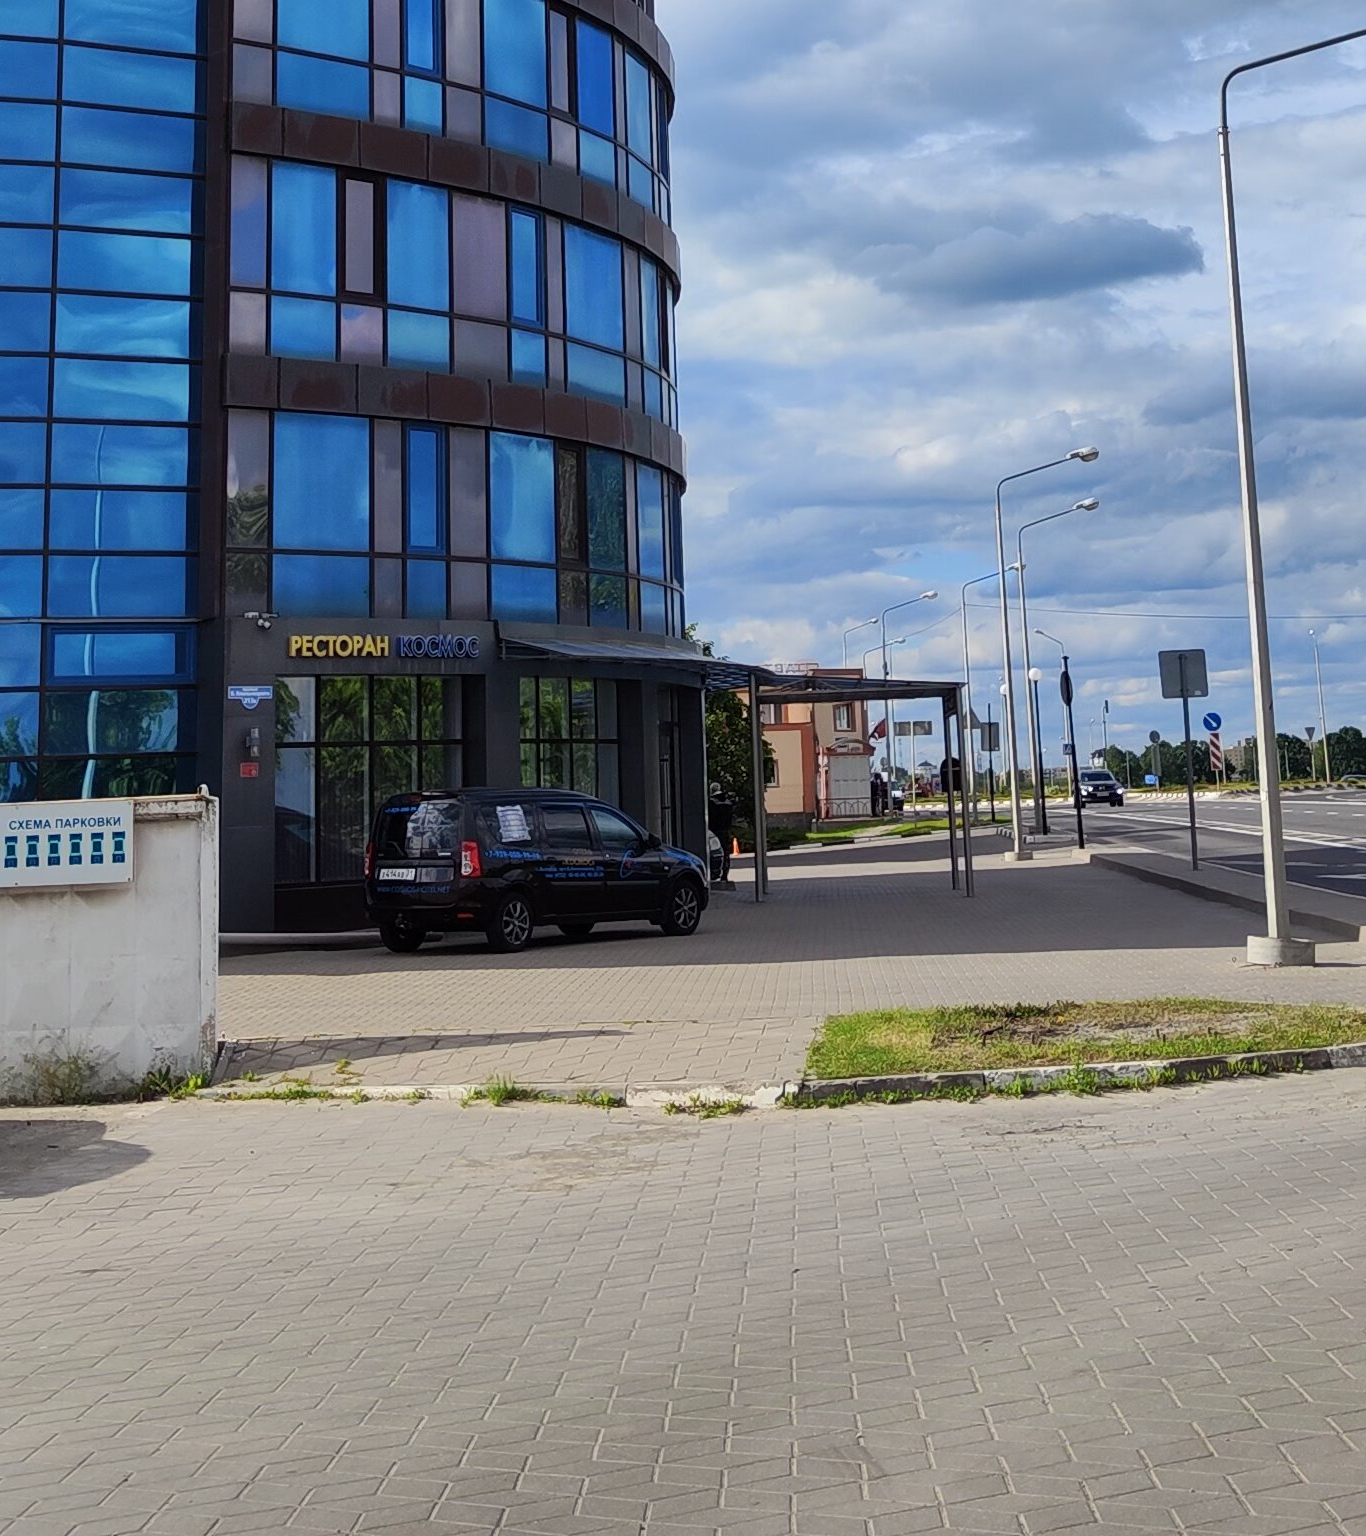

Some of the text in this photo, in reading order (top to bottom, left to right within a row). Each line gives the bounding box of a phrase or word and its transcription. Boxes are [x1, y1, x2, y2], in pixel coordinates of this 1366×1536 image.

[288, 633, 480, 659] РЕСТОРАН КОСМОС
[8, 816, 122, 831] СХЕМА ПАРКОВКИ
